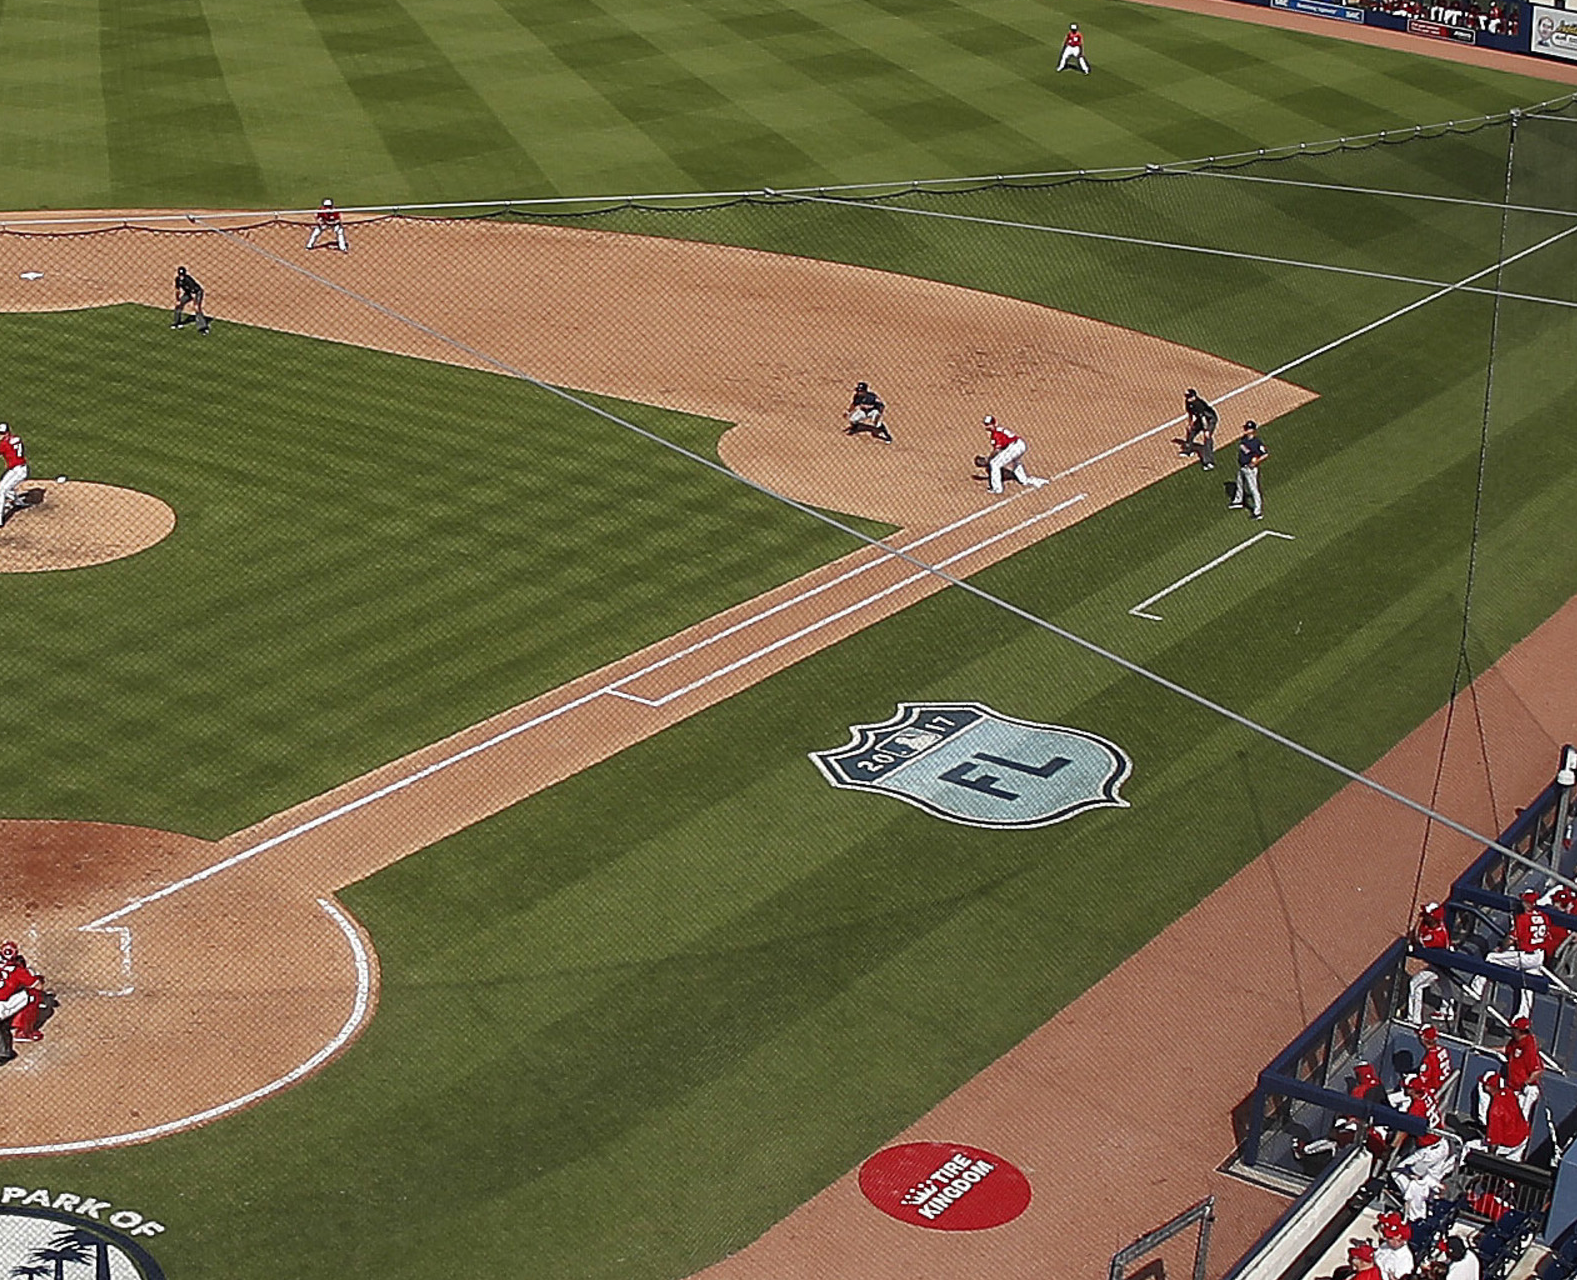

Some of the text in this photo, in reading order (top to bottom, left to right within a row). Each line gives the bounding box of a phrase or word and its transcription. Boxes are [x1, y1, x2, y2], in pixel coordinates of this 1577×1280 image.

[938, 752, 1073, 802] FL
[929, 1153, 973, 1184] TIRE
[917, 1159, 996, 1220] KINGDOM
[108, 1209, 166, 1239] OF
